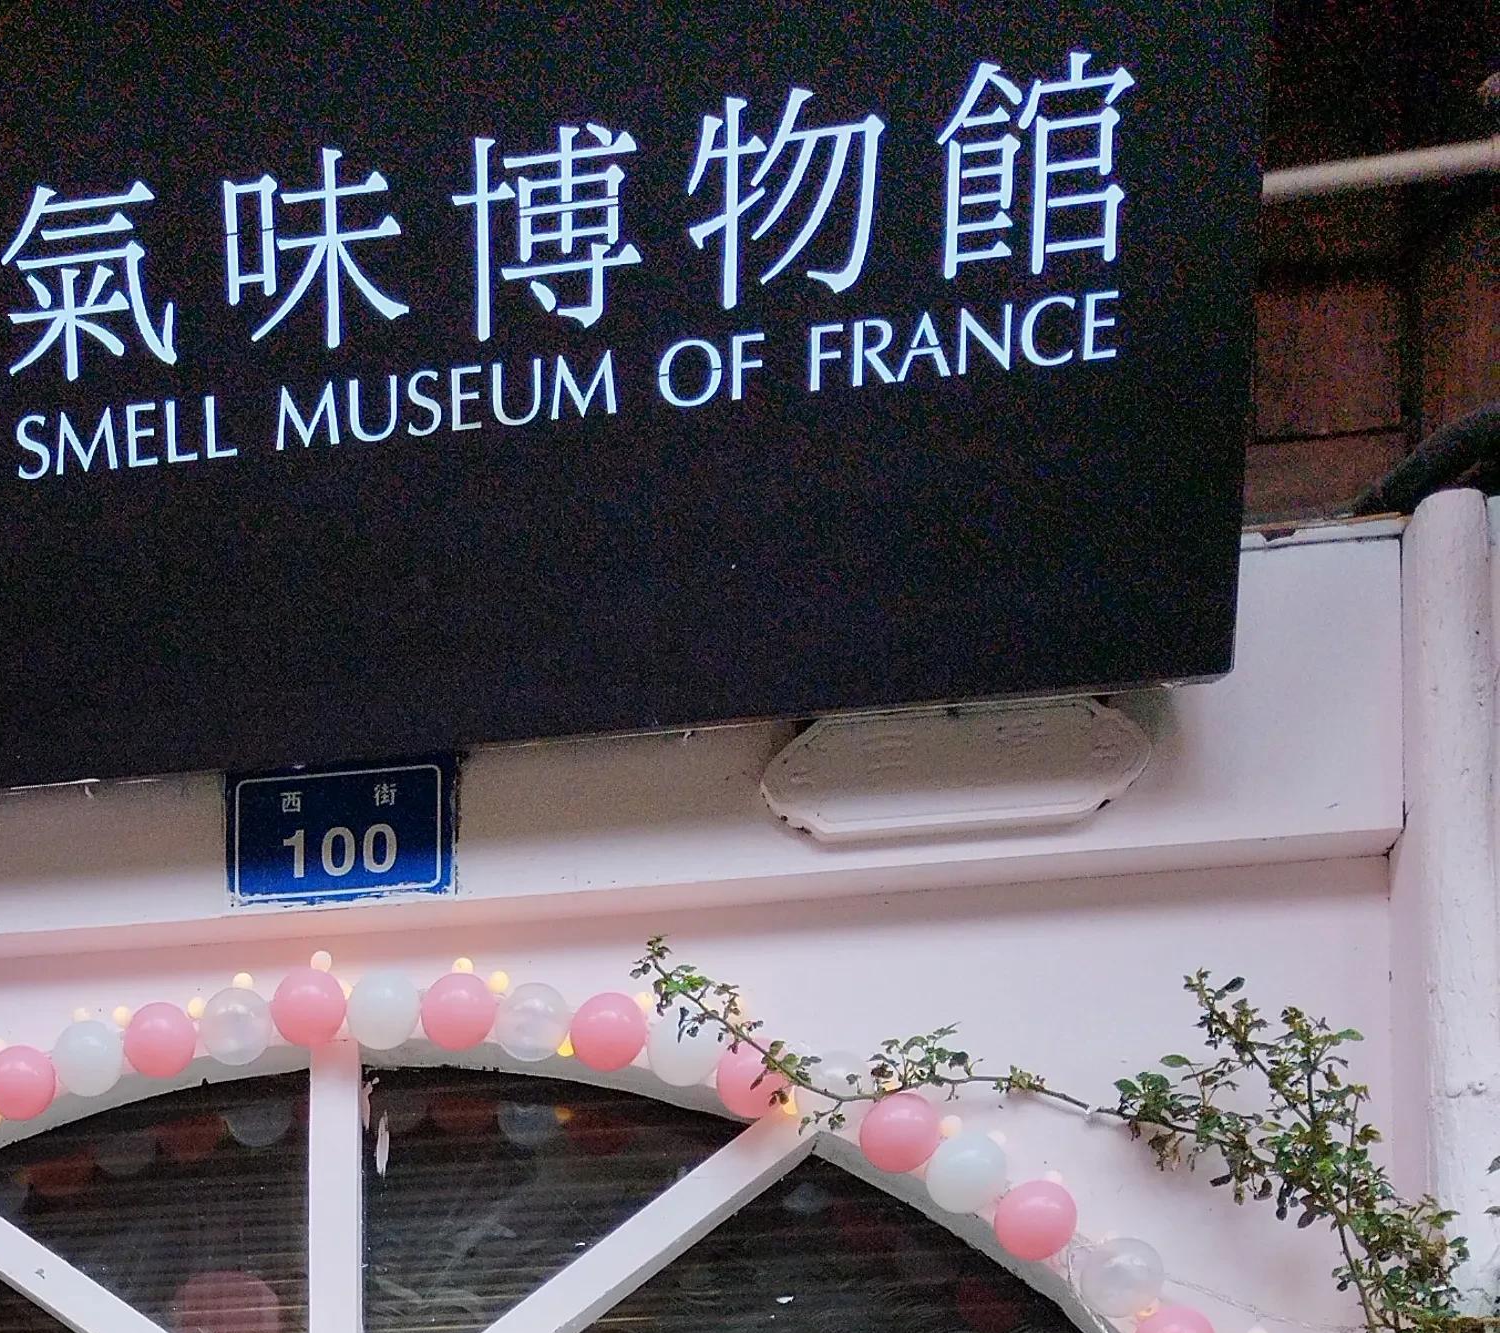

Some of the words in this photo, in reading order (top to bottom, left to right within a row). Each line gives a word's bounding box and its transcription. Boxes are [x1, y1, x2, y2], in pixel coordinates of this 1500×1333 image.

[1, 52, 1136, 382] 氣味博物館
[16, 395, 238, 481] SMELL
[275, 349, 617, 451] MUSEUM
[658, 333, 766, 407] OF
[809, 291, 1119, 392] FRANCE
[280, 783, 398, 813] 西街
[283, 823, 398, 879] 100
